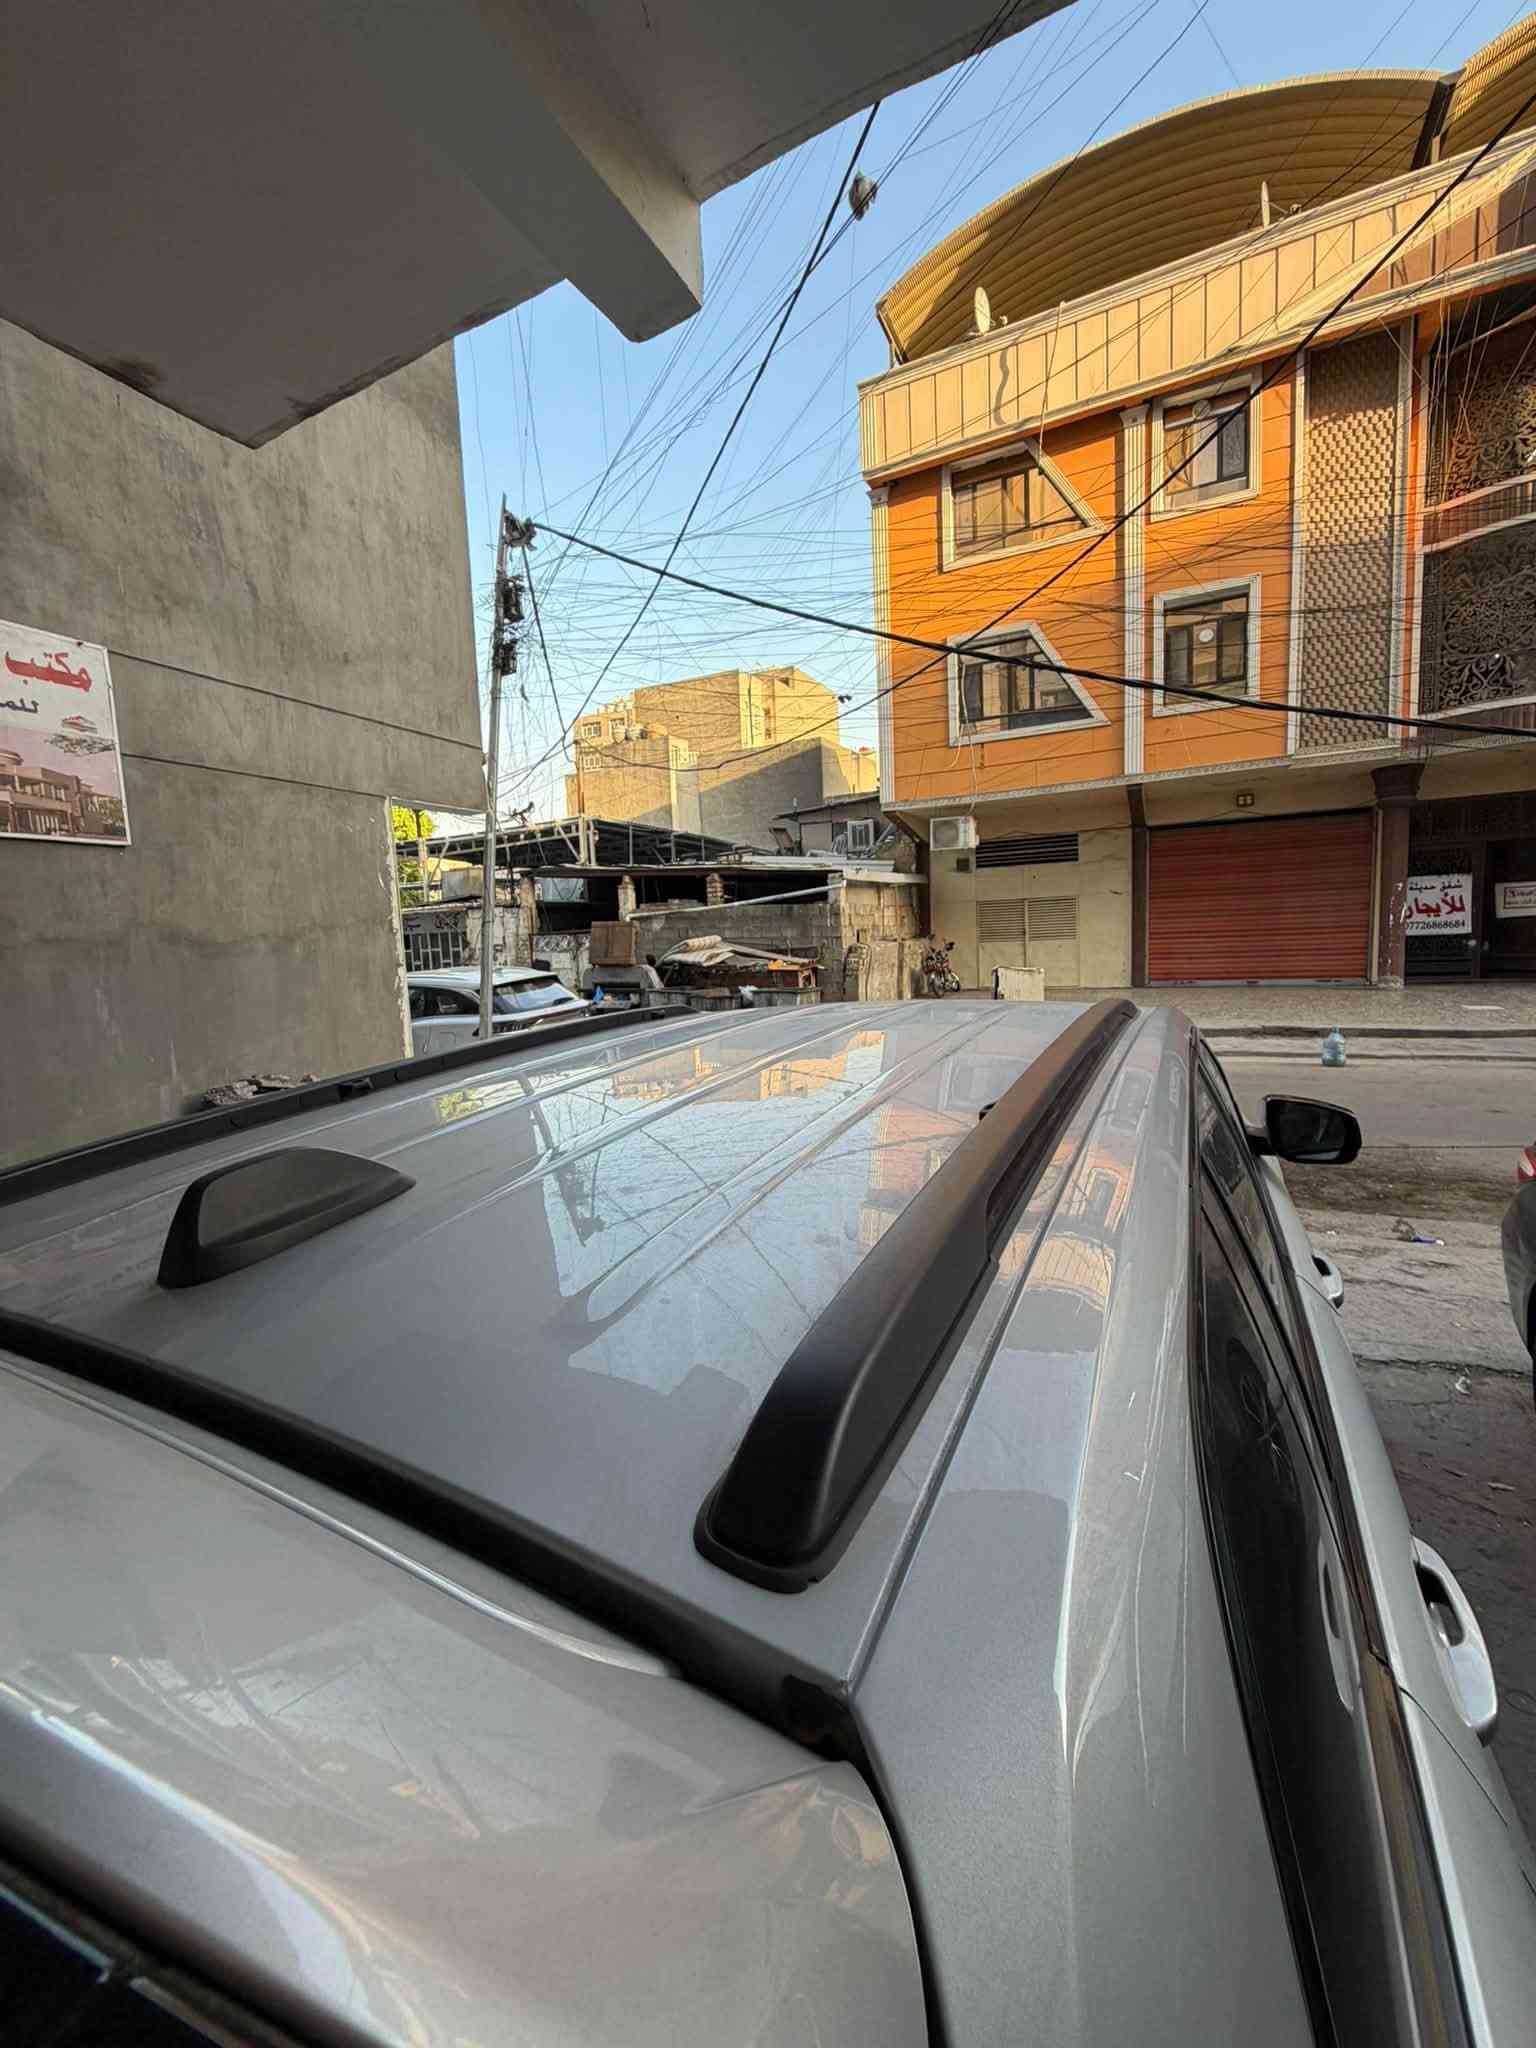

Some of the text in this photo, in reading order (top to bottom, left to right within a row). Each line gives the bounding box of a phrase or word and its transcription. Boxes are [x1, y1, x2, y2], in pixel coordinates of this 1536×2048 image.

[4, 650, 92, 693] مكتب
[0, 697, 39, 714] للم
[1408, 879, 1463, 893] شقق حديثة
